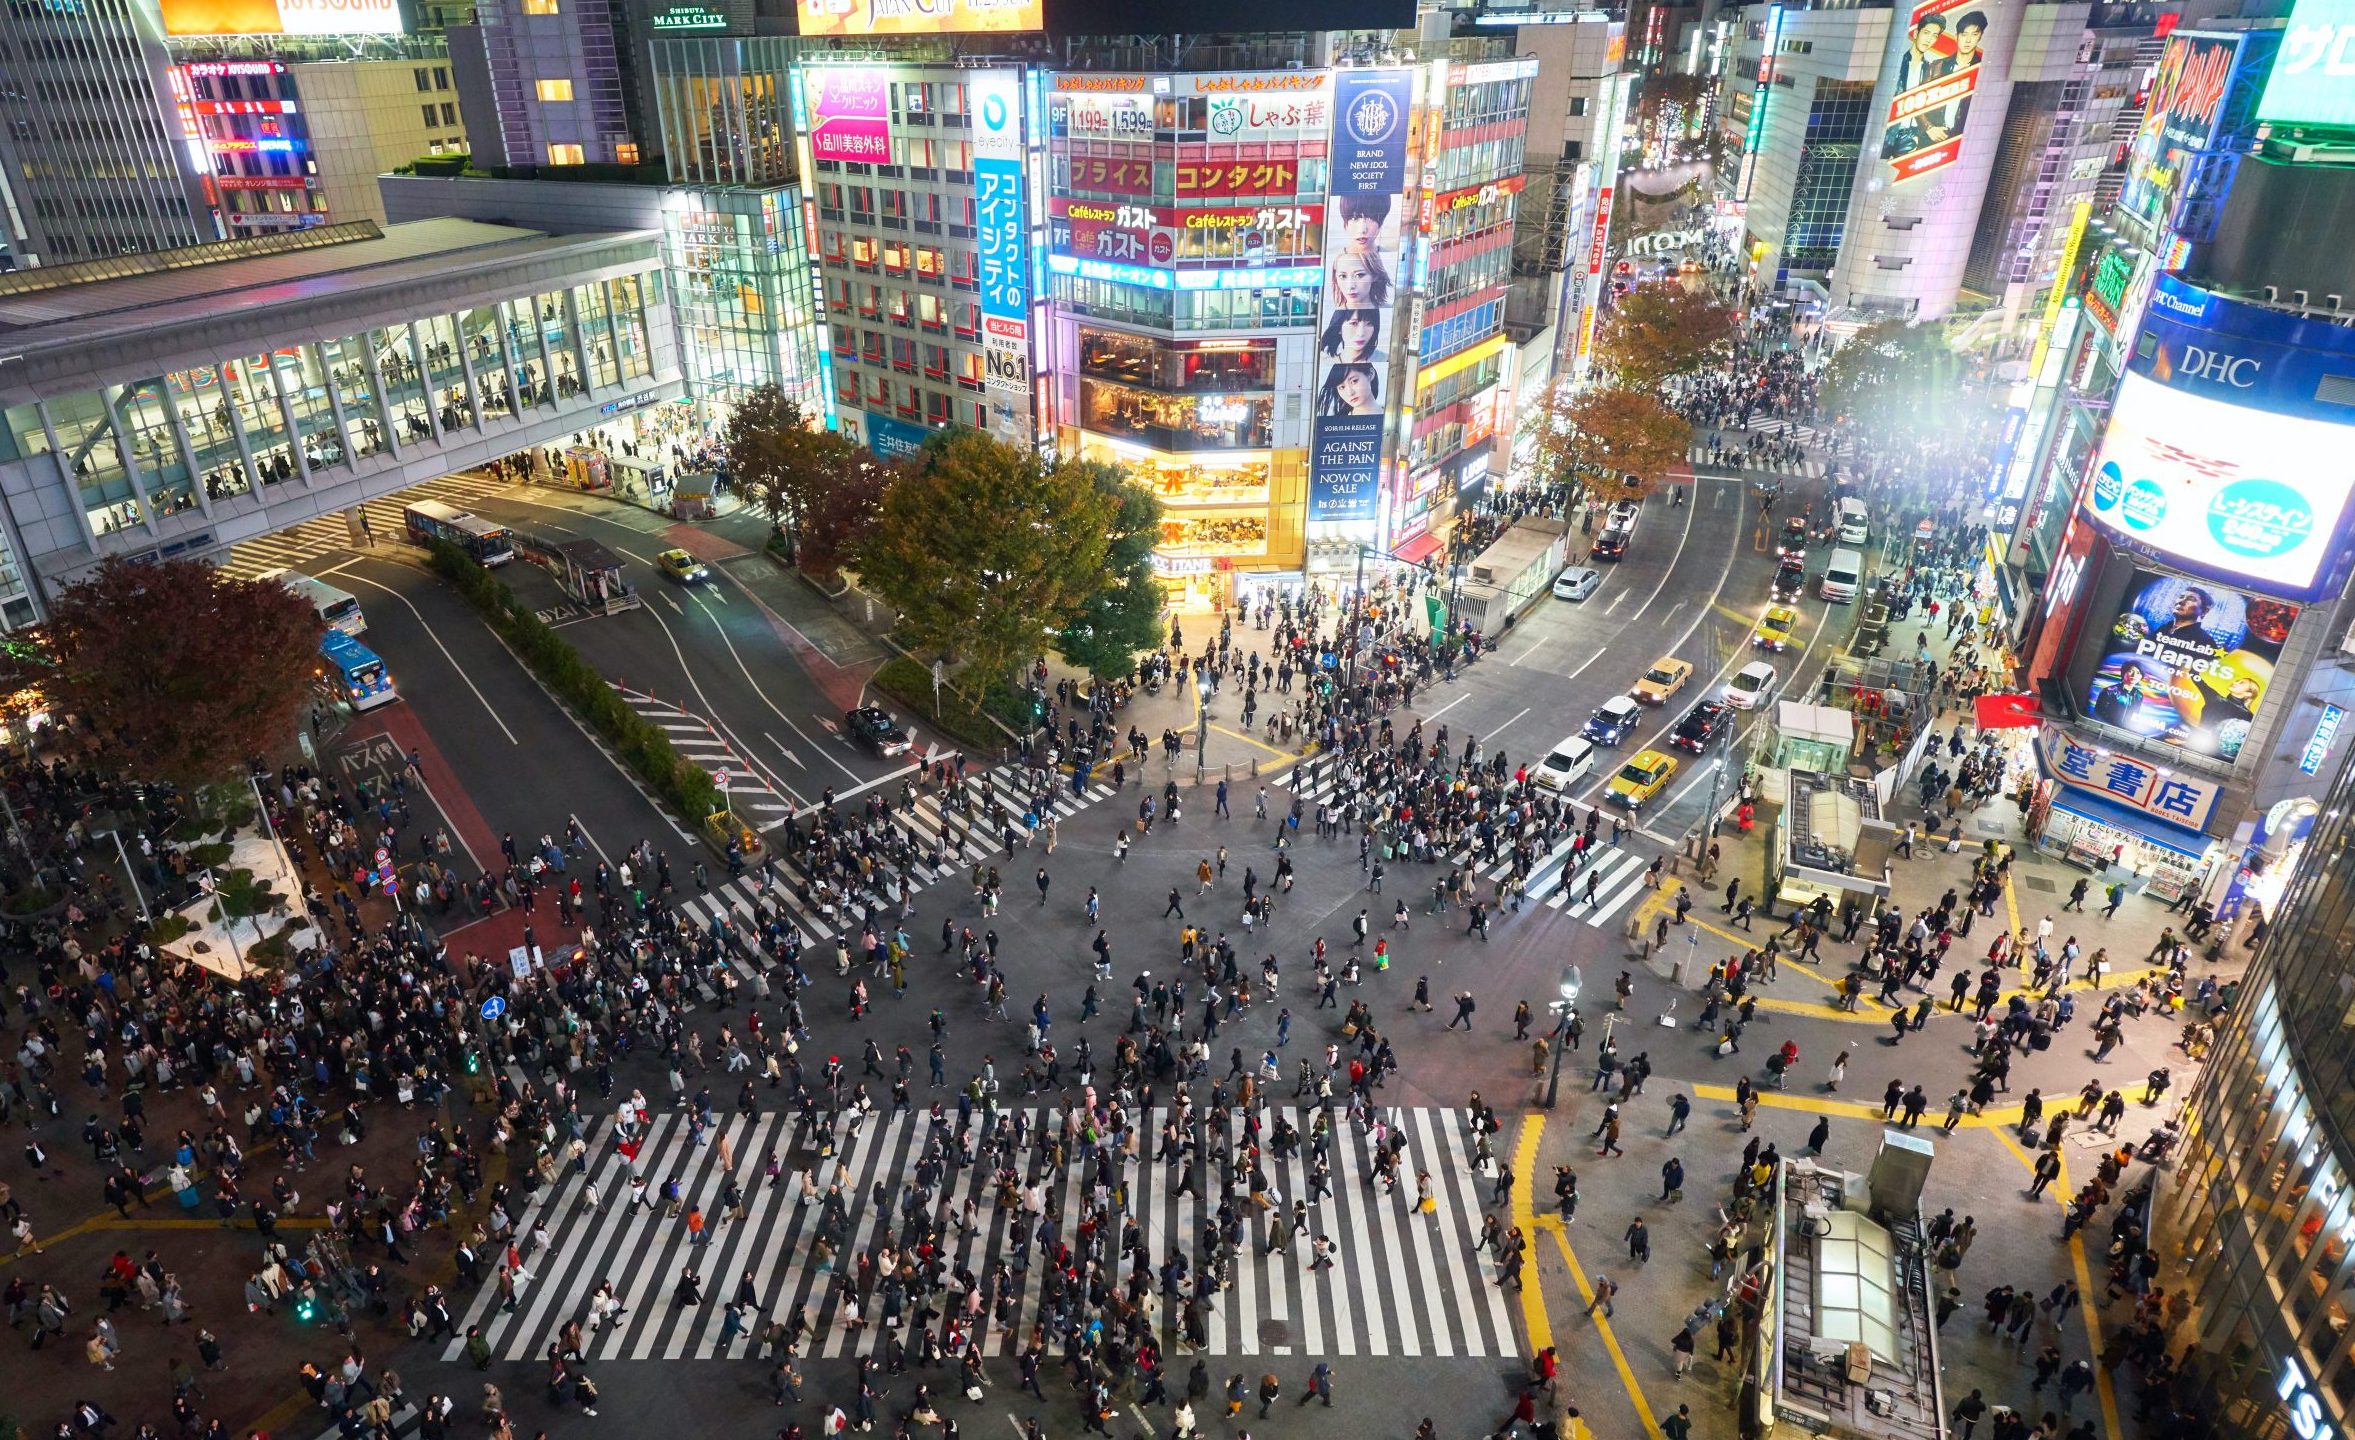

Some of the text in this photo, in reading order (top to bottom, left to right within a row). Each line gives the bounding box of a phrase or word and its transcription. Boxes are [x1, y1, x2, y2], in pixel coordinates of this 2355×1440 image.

[654, 14, 724, 25] MARK CITY
[191, 64, 225, 76] カラオケ
[228, 64, 270, 75] JOYSOUND
[1056, 76, 1145, 91] しゃぶしゃぶバイキング
[1195, 75, 1325, 92] しゃぶしゃぶバイキング
[841, 96, 878, 110] クリニック
[1051, 107, 1067, 121] 9F
[1250, 101, 1324, 127] しゃぶ葉
[824, 133, 886, 155] 品川美容外科
[978, 136, 1015, 151] eyecity
[1356, 150, 1384, 158] BRAND
[1350, 161, 1388, 169] NEW IDOL
[1071, 160, 1149, 187] プライス
[1177, 164, 1293, 189] コンタクト
[1352, 172, 1384, 180] SOCIETY
[1358, 182, 1378, 190] FIRST
[1068, 204, 1156, 229] Caféレストラン ガスト
[1186, 208, 1310, 230] Caféレストラン ガスト
[980, 173, 1003, 304] アイシティ
[1003, 175, 1021, 307] コンタクトの
[1054, 228, 1071, 245] 7F
[1075, 230, 1095, 243] Café
[1097, 230, 1144, 259] ガスト
[1154, 245, 1171, 254] ガスト
[2154, 289, 2205, 317] DHC Channel
[990, 322, 1022, 337] 当ビル5階
[992, 338, 1017, 349] 利用者数
[986, 349, 1027, 383] No.1
[2179, 345, 2261, 387] DHC
[986, 377, 1027, 393] コンタクトショップ
[1320, 455, 1344, 464] THE
[1320, 473, 1371, 483] NOW ON
[1332, 484, 1357, 493] SALE
[2141, 544, 2161, 560] DHC
[2156, 632, 2215, 656] teamLab
[2136, 638, 2236, 680] Planets
[2150, 680, 2199, 701] TOYOSU
[2277, 1355, 2334, 1440] TS
